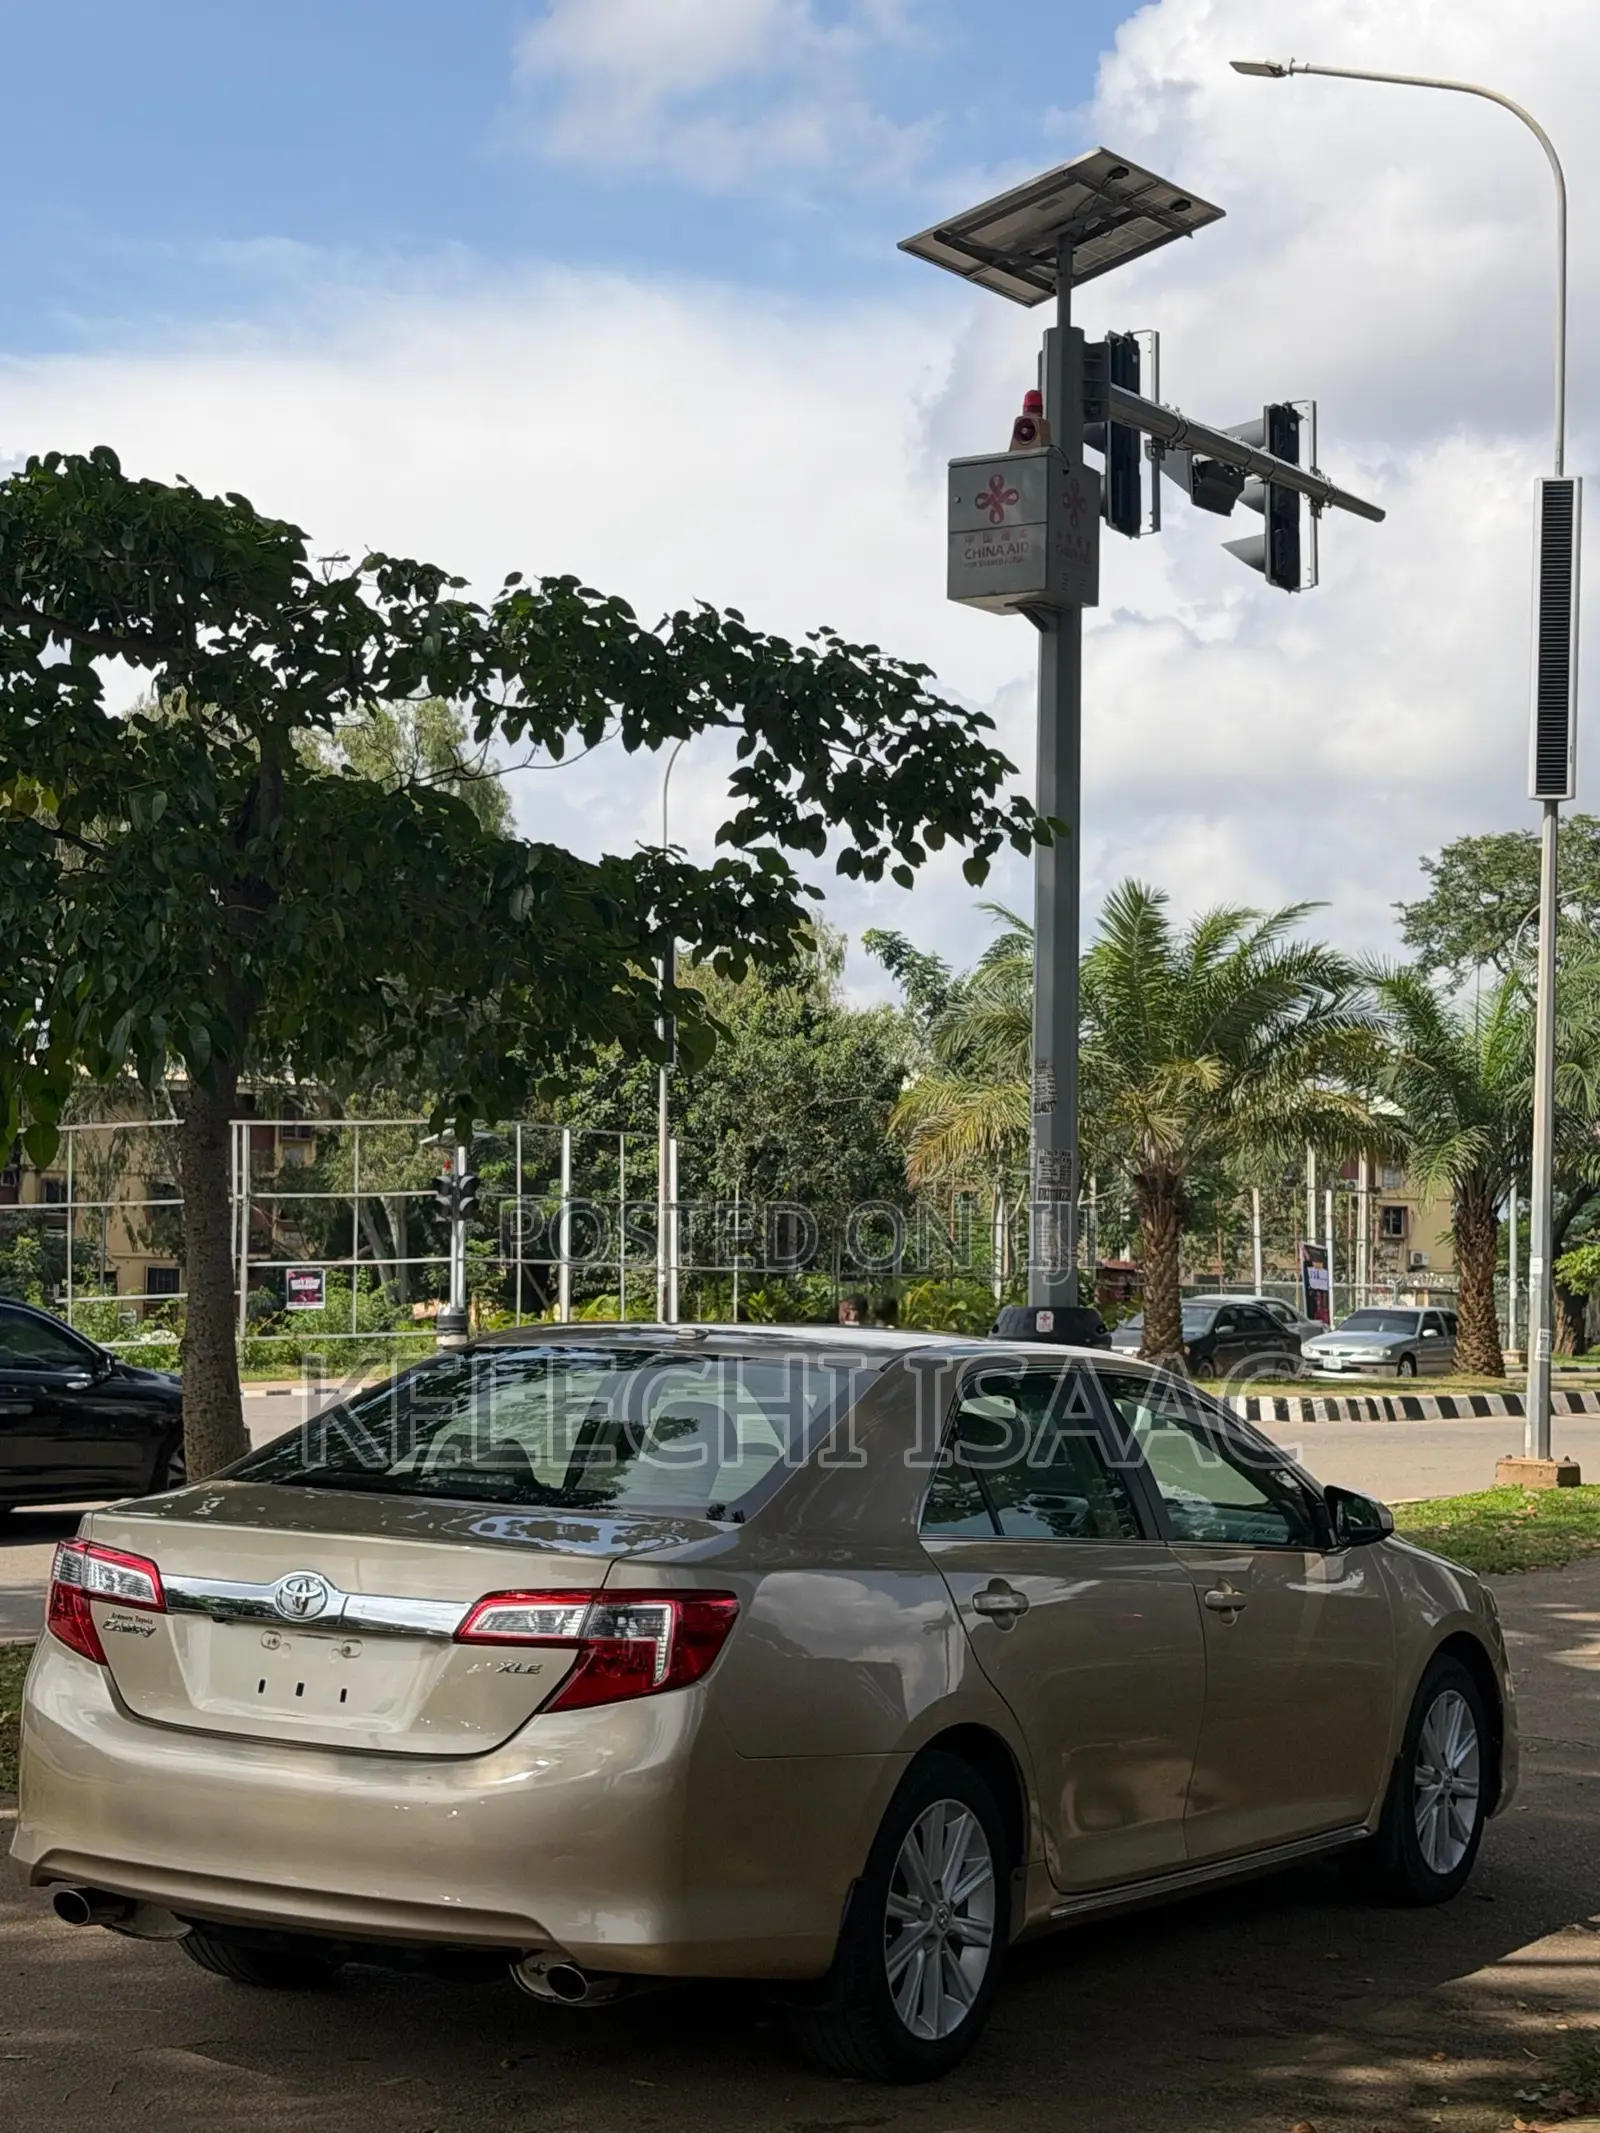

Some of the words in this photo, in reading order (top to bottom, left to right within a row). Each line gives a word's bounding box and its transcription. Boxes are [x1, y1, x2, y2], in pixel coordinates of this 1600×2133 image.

[964, 543, 1005, 560] CHINA
[1006, 541, 1030, 556] AID
[495, 1661, 543, 1675] XLE
